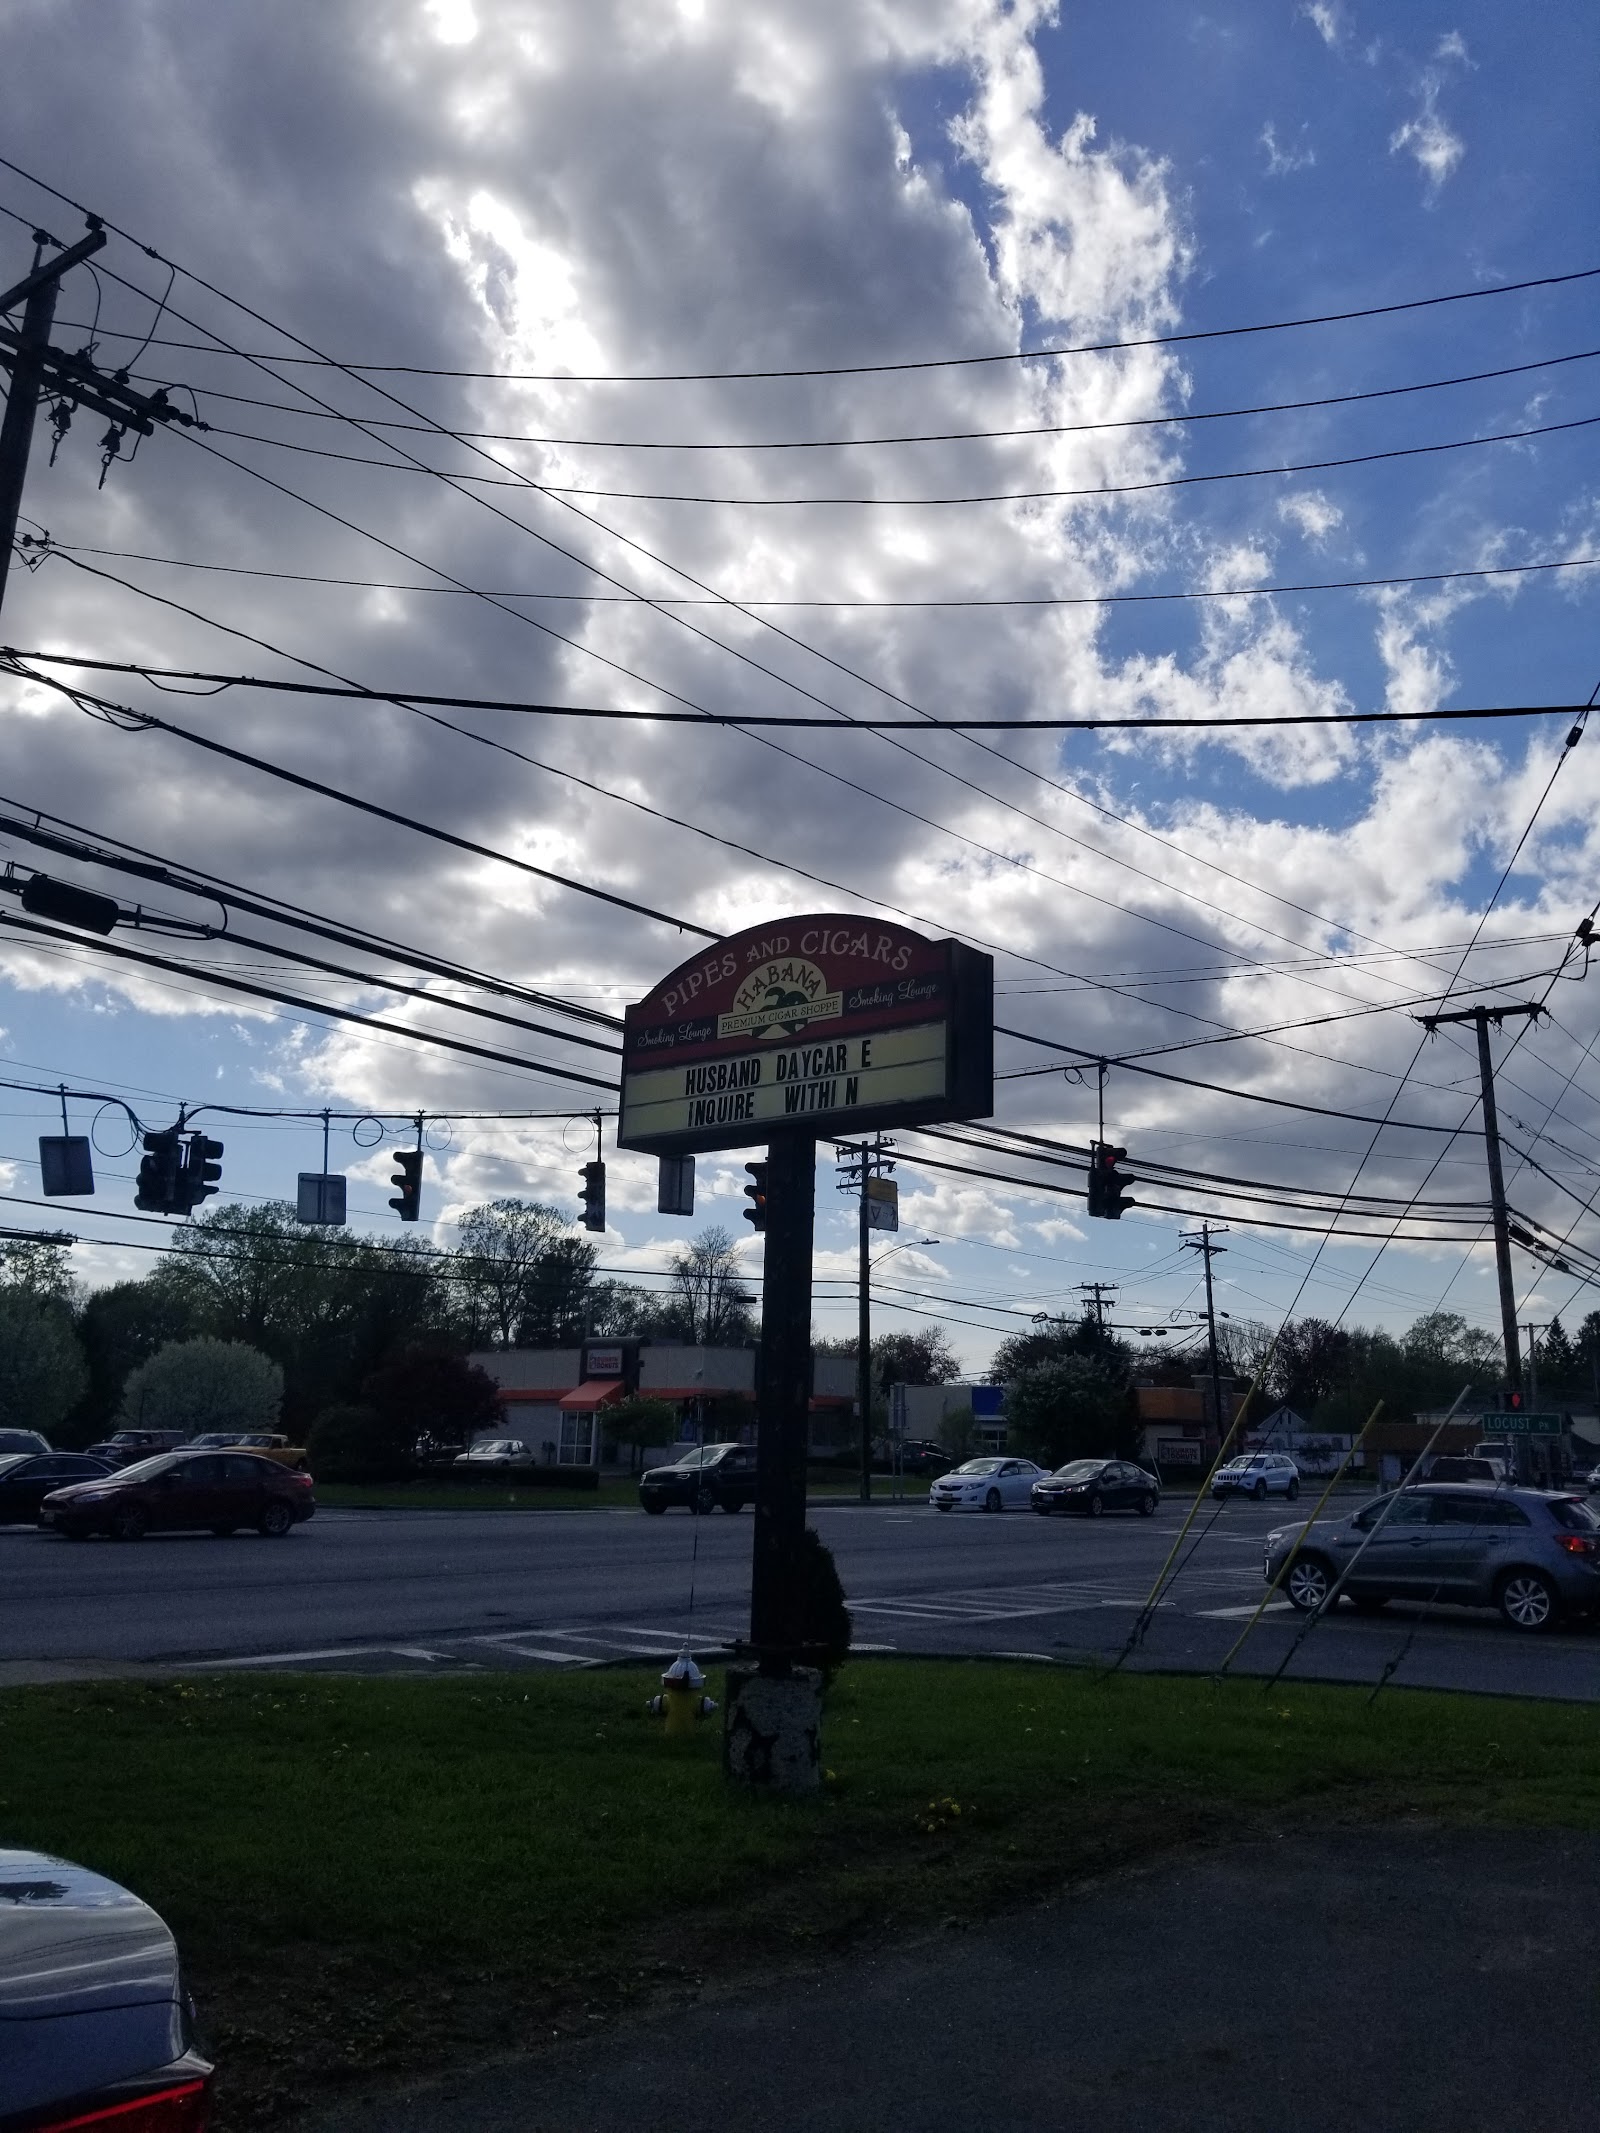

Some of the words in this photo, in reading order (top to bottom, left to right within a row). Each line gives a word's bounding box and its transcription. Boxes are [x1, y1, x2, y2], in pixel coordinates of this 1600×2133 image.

[661, 953, 737, 1017] PIPES
[747, 936, 790, 963] AND
[800, 930, 912, 971] CIGARS
[737, 962, 821, 1011] HABANA
[849, 987, 894, 1009] Smoking
[897, 979, 937, 1000] Lounge
[721, 1015, 765, 1031] PREMIUM
[768, 1008, 798, 1023] CIGAR
[800, 1000, 838, 1016] SHOPPE
[637, 1029, 675, 1047] Smoking
[678, 1022, 711, 1041] Lounge
[685, 1058, 761, 1096] HUSBAND
[688, 1091, 754, 1127] INQUIRE
[1487, 1416, 1531, 1430] LOCUST
